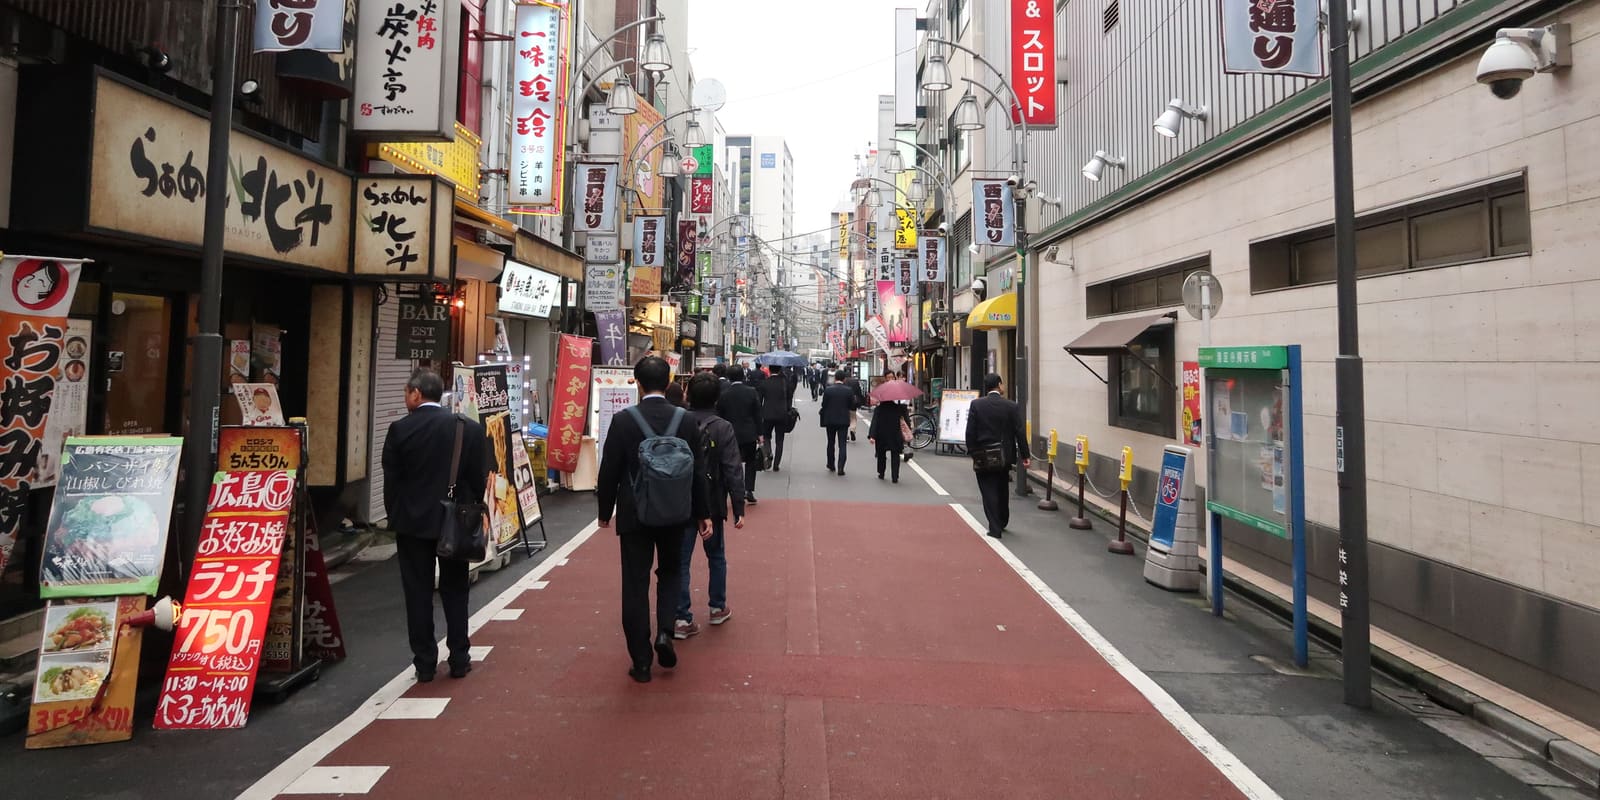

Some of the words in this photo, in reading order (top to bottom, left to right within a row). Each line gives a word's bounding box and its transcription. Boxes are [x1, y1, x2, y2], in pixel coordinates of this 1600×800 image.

[270, 0, 314, 46] り
[376, 4, 418, 101] 炭火亭
[517, 31, 552, 138] 一味玲玲
[1022, 29, 1044, 118] スロット
[130, 127, 210, 205] らぁめ
[533, 160, 544, 197] 羊肉串
[240, 155, 333, 255] 北斗
[363, 182, 428, 206] らぁめん
[692, 180, 702, 211] ラーメン
[371, 210, 418, 272] 北斗
[401, 304, 447, 321] BAR
[411, 326, 436, 337] EST
[410, 348, 433, 359] B1F
[230, 451, 290, 469] ちんちくりん
[207, 473, 263, 509] 広島
[198, 519, 285, 555] お好み焼
[193, 561, 275, 601] ランチ
